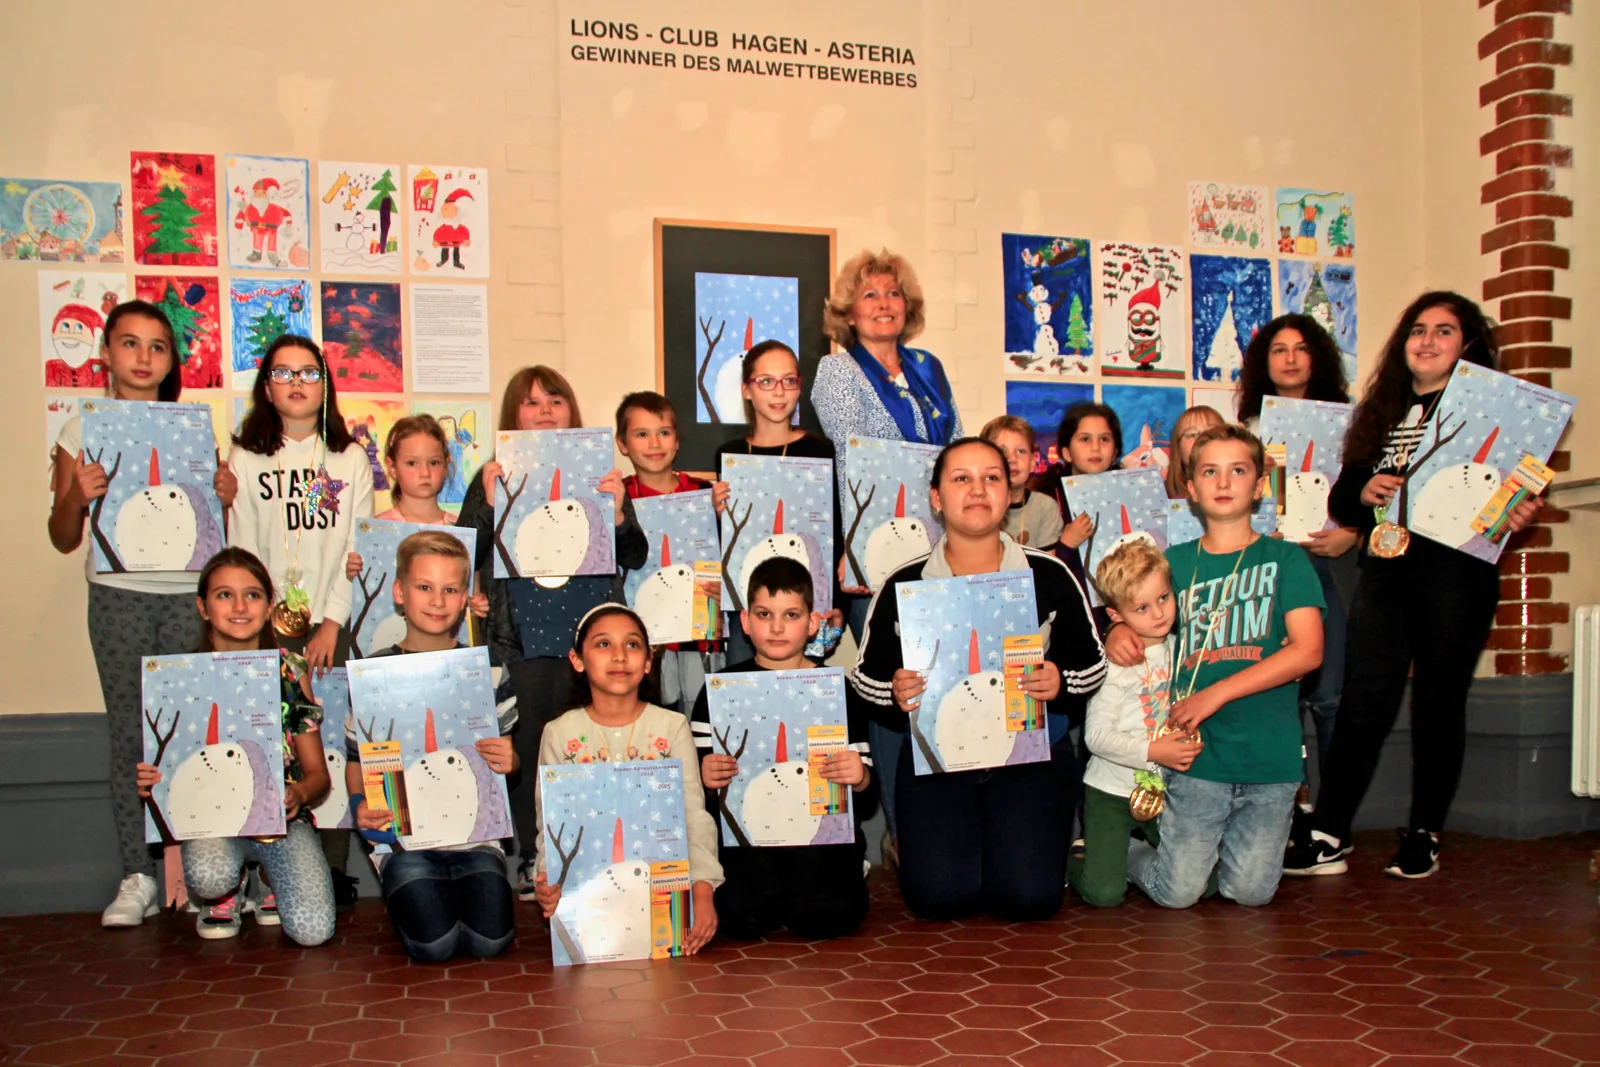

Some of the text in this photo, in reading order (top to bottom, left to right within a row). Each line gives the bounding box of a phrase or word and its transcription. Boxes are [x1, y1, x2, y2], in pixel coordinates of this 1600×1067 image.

[570, 19, 639, 41] LIONS
[660, 26, 719, 48] CLUB
[732, 33, 808, 56] HAGEN
[827, 42, 916, 65] ASTERIA
[570, 45, 918, 88] GEWINNER DES MALWETTBEWERBES
[1372, 446, 1416, 474] adida
[1178, 561, 1278, 621] RETOUR
[1216, 648, 1255, 659] QUALITY
